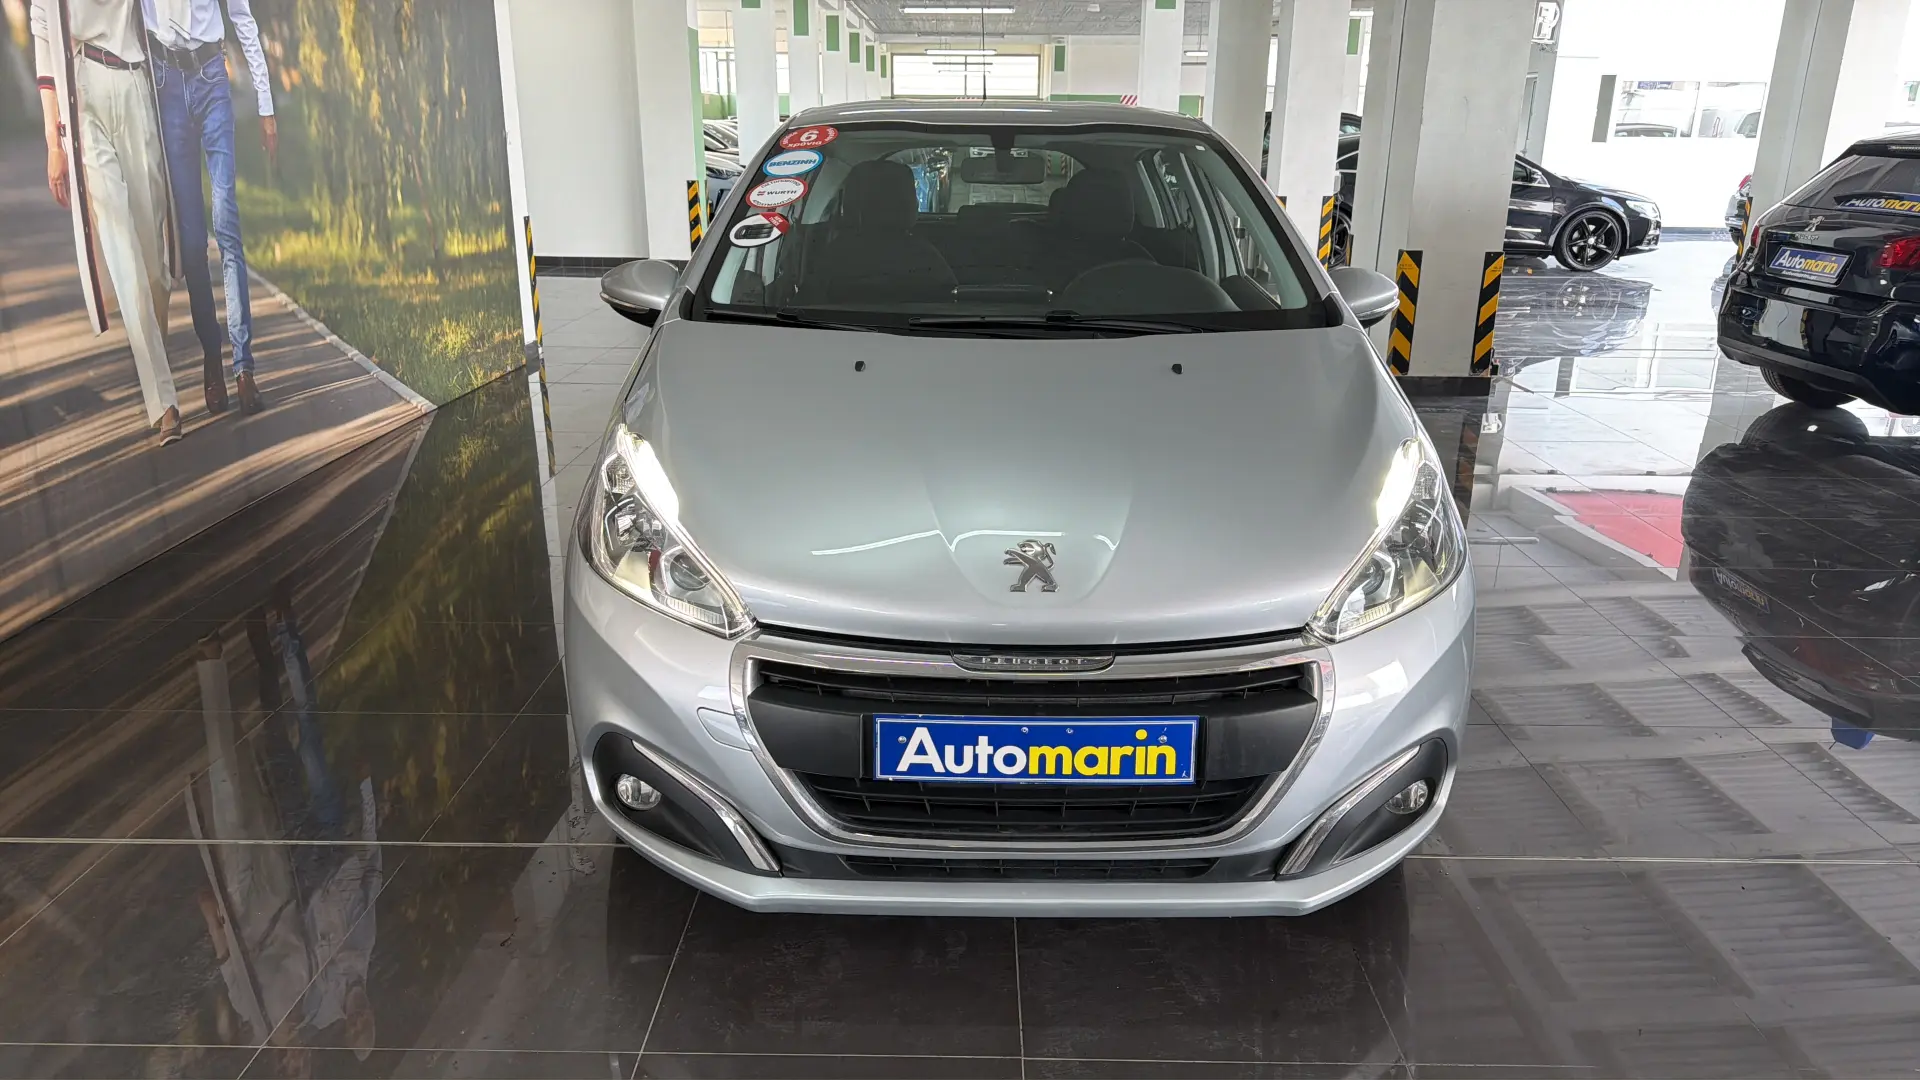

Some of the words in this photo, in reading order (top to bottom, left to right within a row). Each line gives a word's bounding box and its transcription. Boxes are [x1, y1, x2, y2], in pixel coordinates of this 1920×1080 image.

[800, 130, 819, 142] 6
[1776, 249, 1838, 274] Automarin
[982, 657, 1083, 666] PEUGEOT
[896, 726, 1177, 775] Automarin
